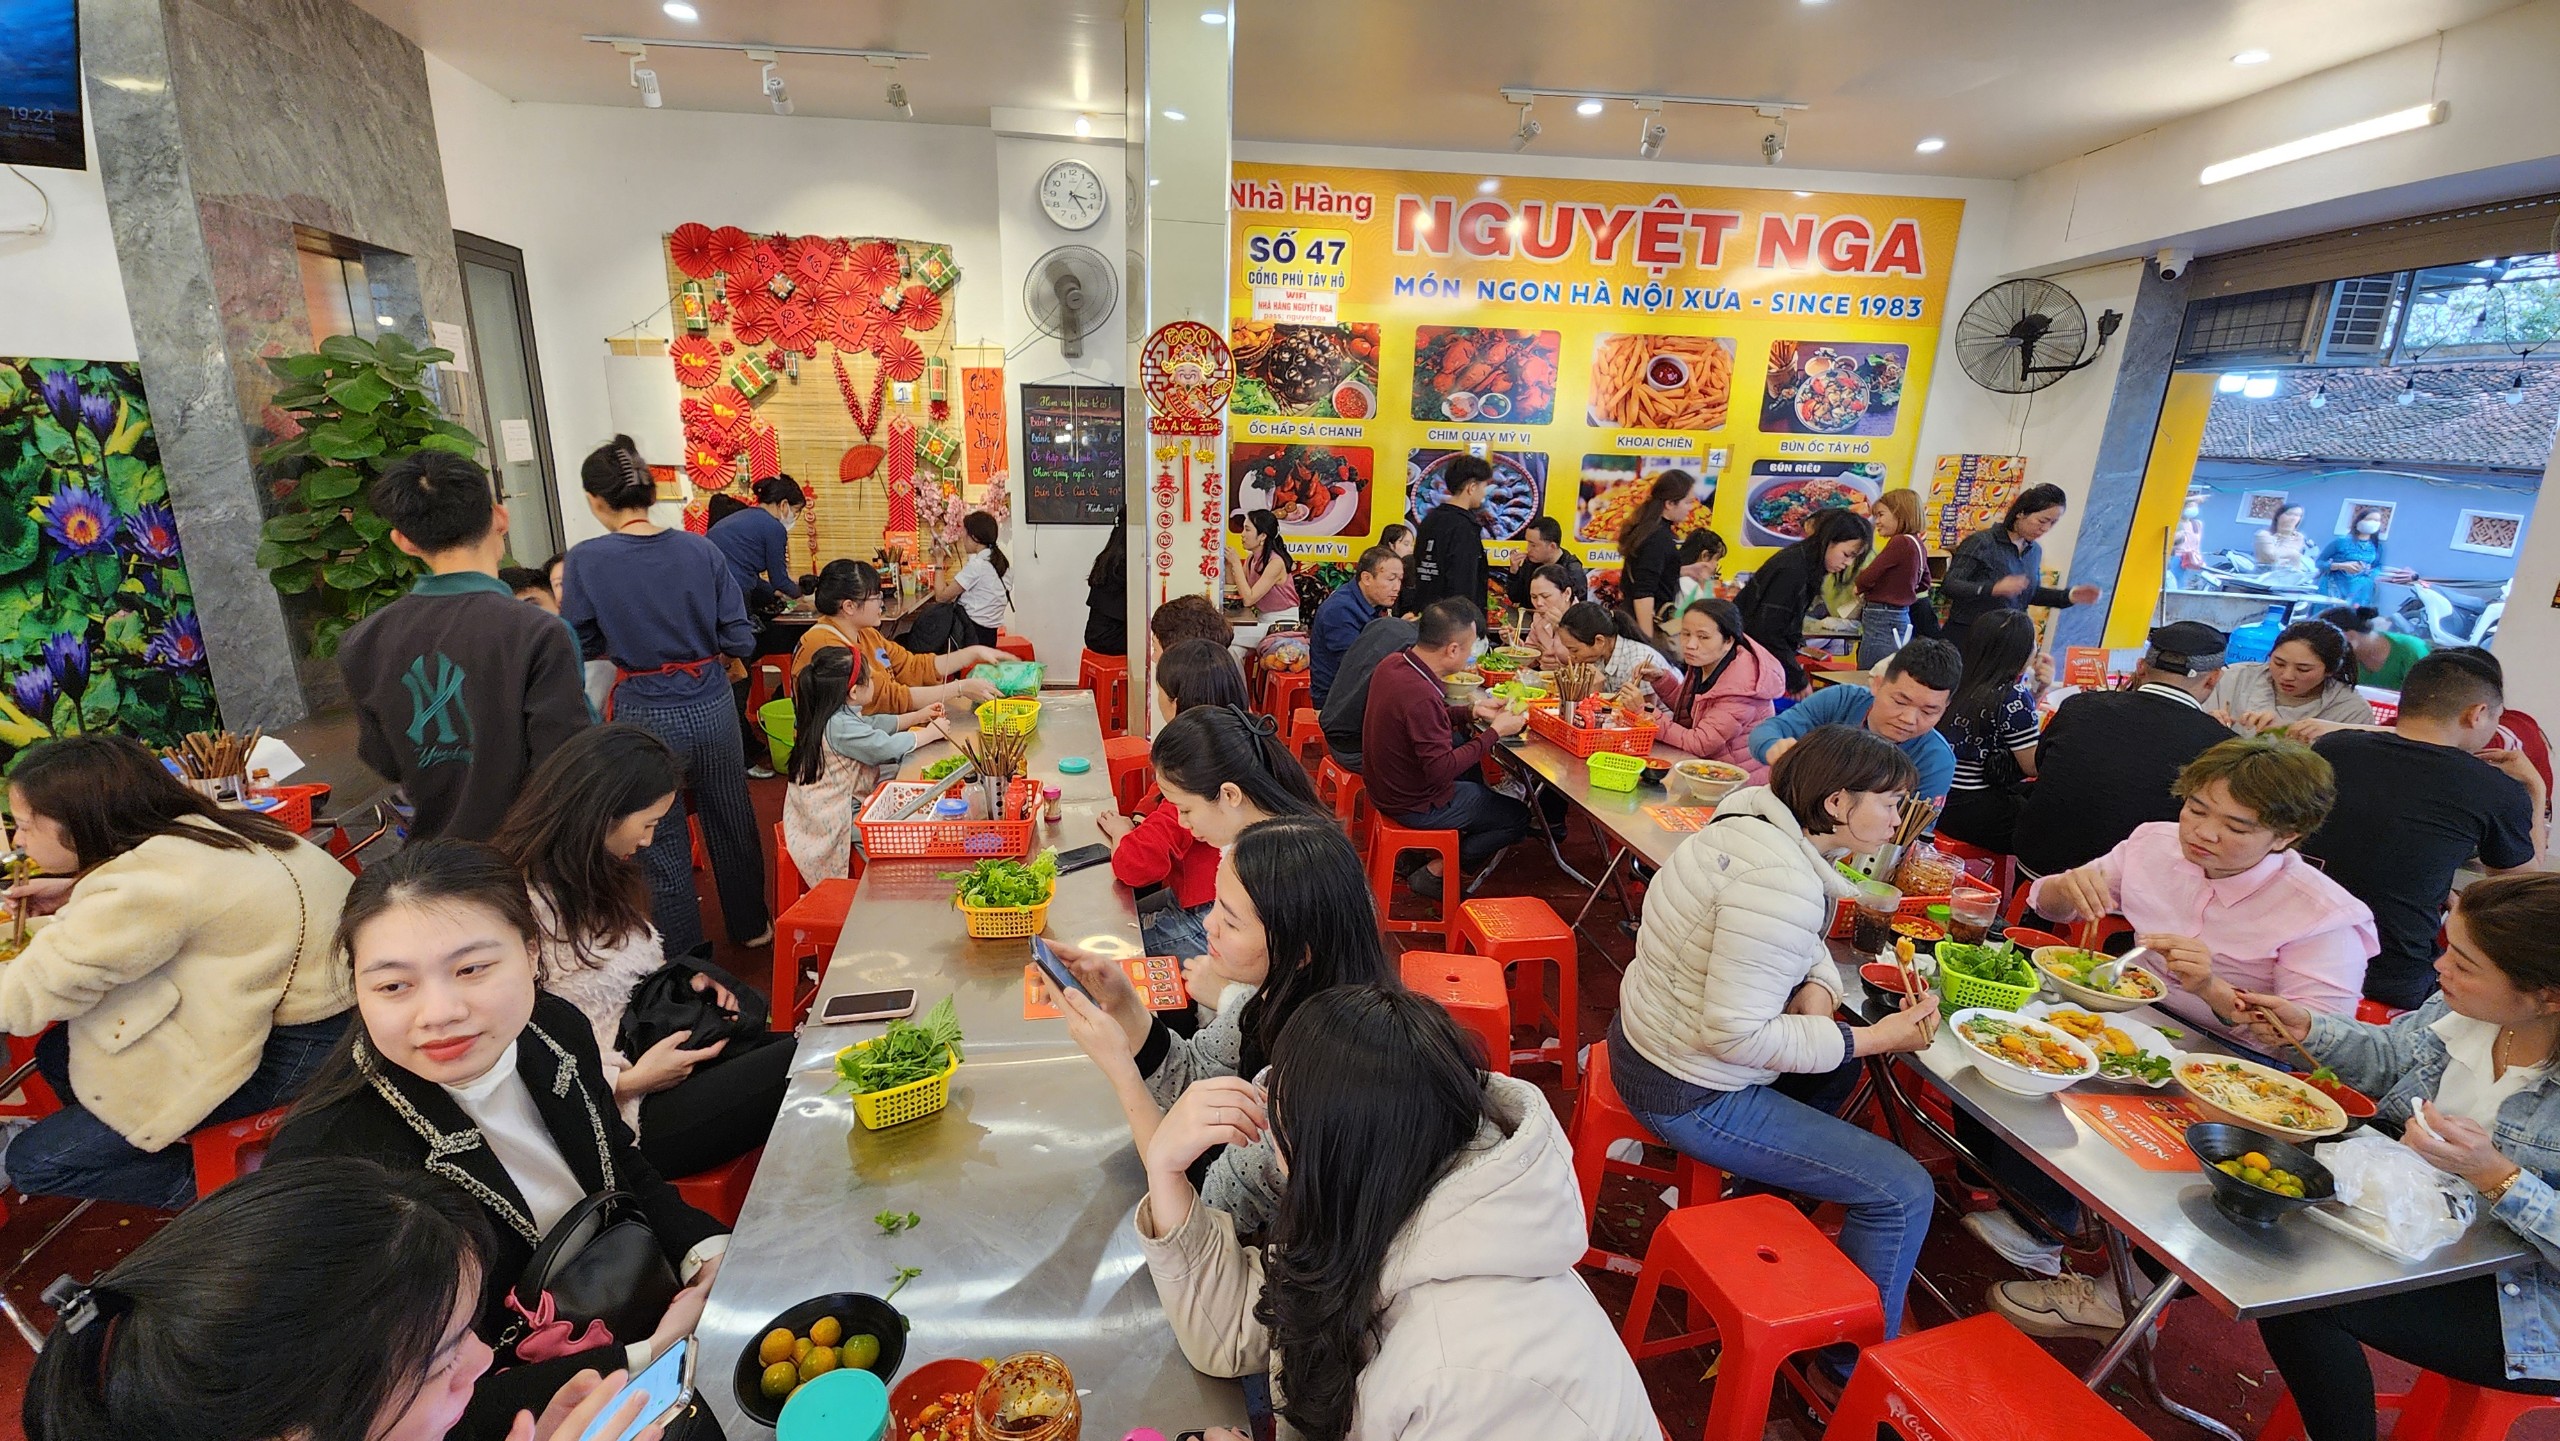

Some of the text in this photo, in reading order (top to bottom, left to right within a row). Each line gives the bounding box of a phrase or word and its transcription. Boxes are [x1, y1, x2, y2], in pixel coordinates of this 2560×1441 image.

[1231, 183, 1372, 220] Nhà Hàng
[1396, 198, 1922, 275] NGUYỆT NGA
[1250, 230, 1346, 265] SỐ 47
[1308, 272, 1326, 287] TÂY
[1331, 270, 1345, 288] HỒ
[1286, 291, 1306, 299] WIFI
[1394, 273, 1460, 298] MÓN
[1477, 281, 1561, 302] NGON
[1572, 281, 1610, 304] HÀ
[1622, 283, 1673, 312] NỘI
[1682, 287, 1741, 310] XƯA
[1770, 293, 1850, 314] SINCE
[1859, 297, 1922, 317] 1983
[1319, 304, 1333, 312] NGA
[898, 387, 908, 401] 1
[1249, 421, 1362, 438] ỐC HẤP SẢ CHANH
[1428, 430, 1458, 441] CHIM
[1462, 431, 1495, 442] QUAY
[1520, 432, 1531, 444] VỊ
[1617, 436, 1693, 449] KHOAI CHIÊN
[1780, 440, 1870, 454] BÚN ỐC TÂY HỒ
[1712, 452, 1720, 464] 4
[1770, 462, 1821, 473] BÚN RIÊU
